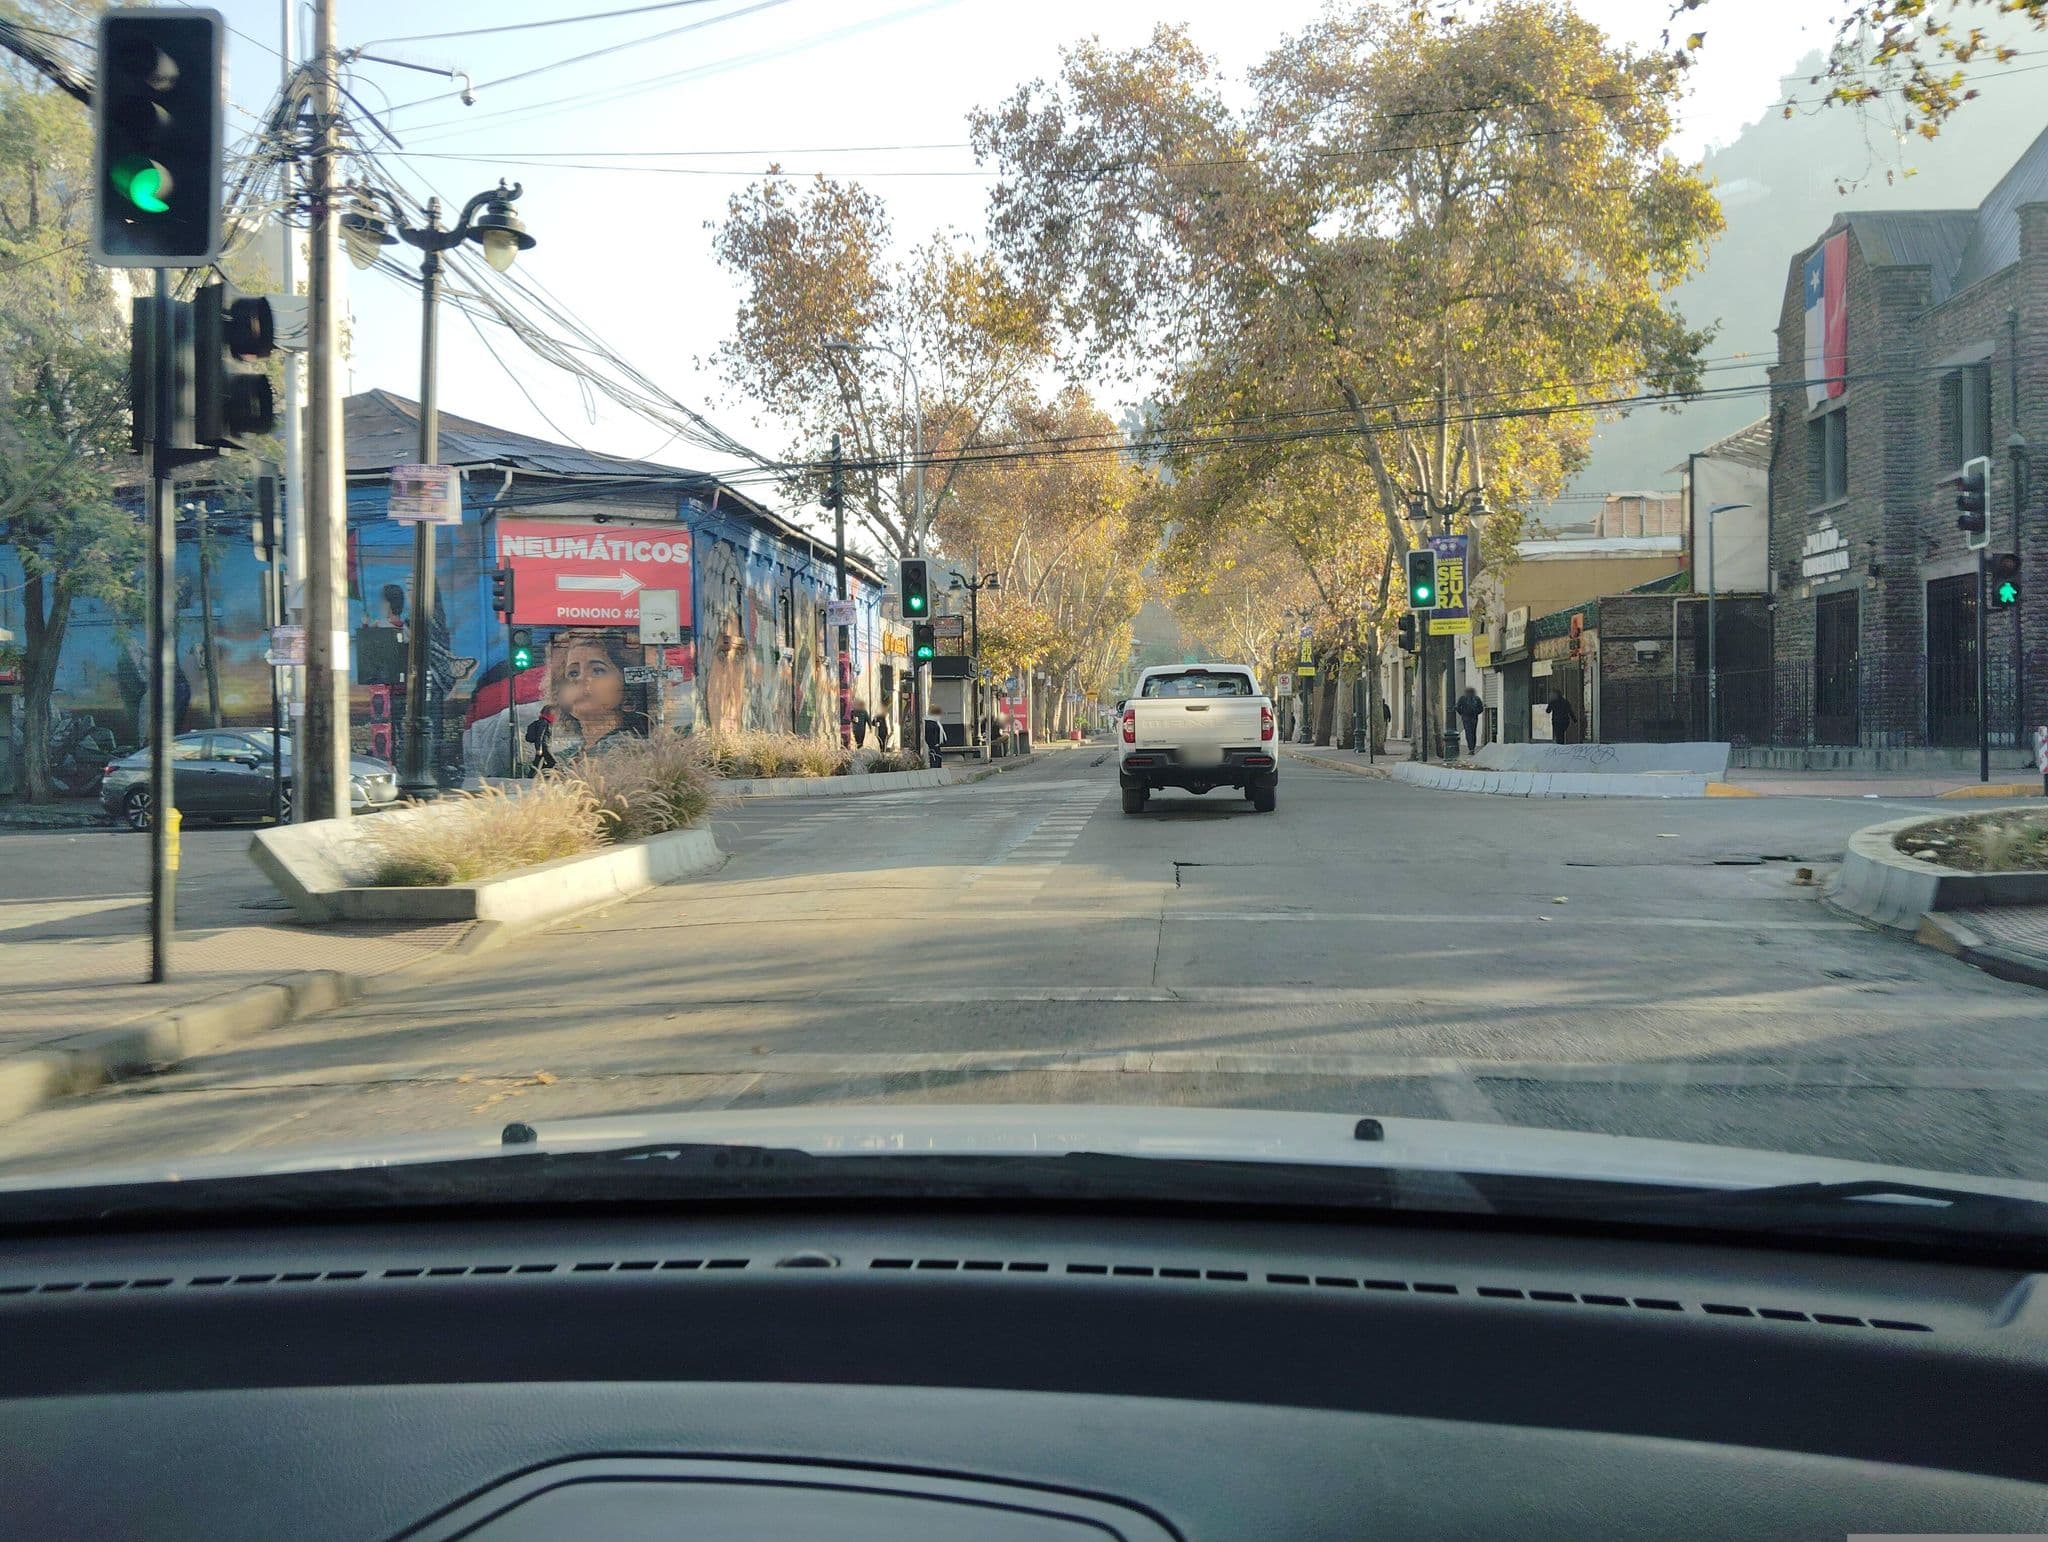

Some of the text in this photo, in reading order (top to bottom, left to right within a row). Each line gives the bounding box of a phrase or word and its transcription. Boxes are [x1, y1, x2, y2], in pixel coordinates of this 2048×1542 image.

[502, 534, 689, 563] NEUMÁTICOS
[1437, 566, 1463, 580] SE
[1437, 581, 1464, 594] GU
[1437, 594, 1465, 609] RA
[556, 606, 621, 618] PIONONO
